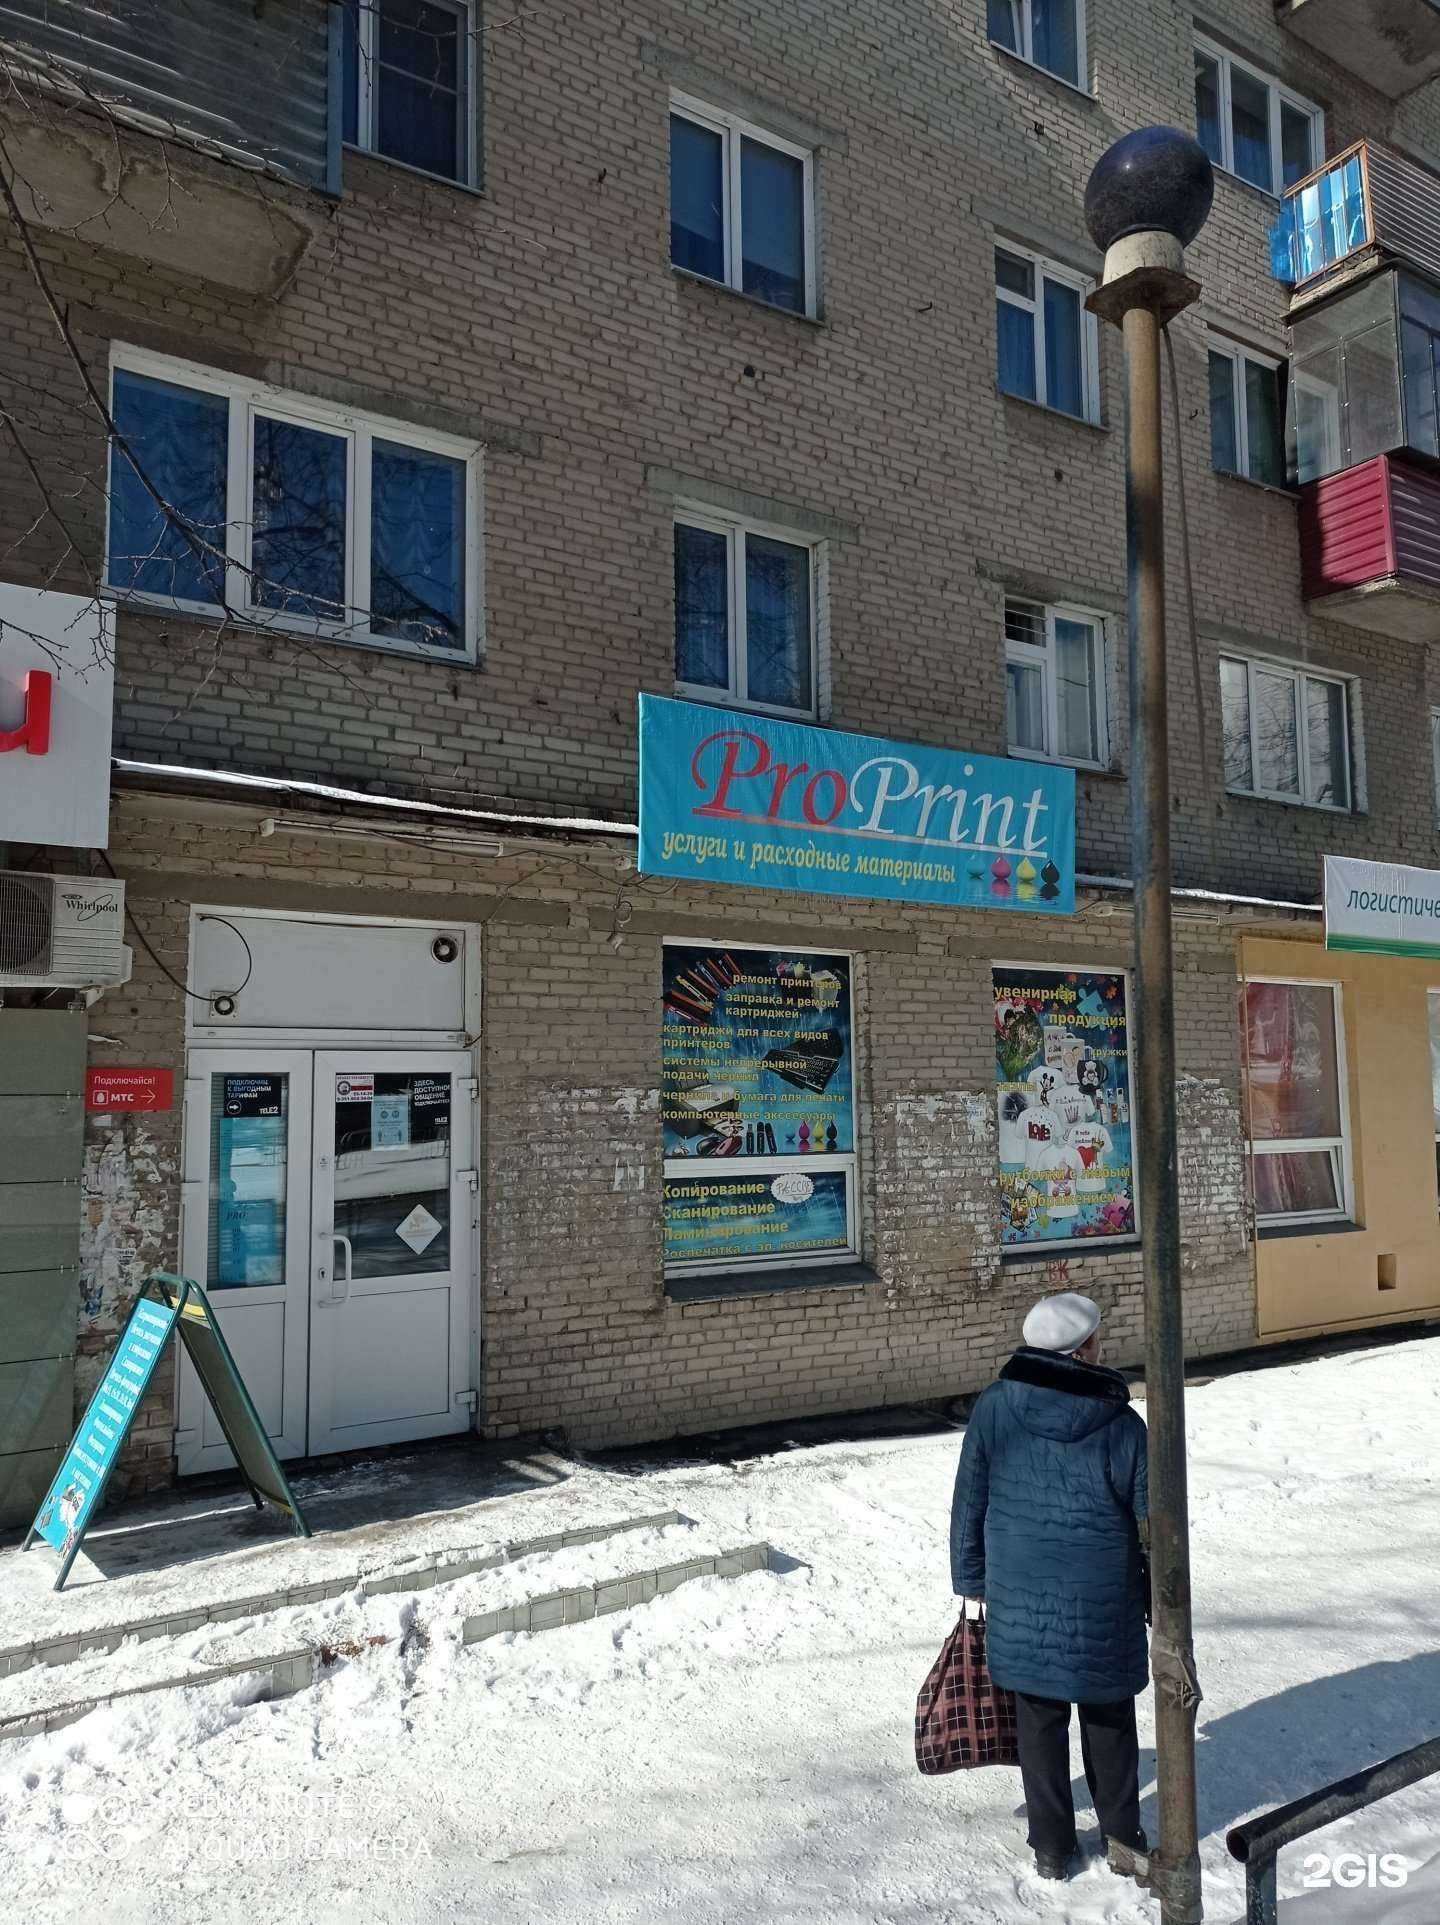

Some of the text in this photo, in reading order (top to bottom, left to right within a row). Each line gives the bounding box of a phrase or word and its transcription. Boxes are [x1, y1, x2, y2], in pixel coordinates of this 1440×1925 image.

[691, 730, 1048, 853] ProPrint
[661, 831, 957, 884] услуги и расходные материалы
[65, 899, 119, 915] Whirlpool
[1347, 889, 1440, 919] логистиче
[733, 974, 842, 990] ремонт принтеров
[726, 994, 841, 1009] заправка и ремонт
[725, 1006, 800, 1019] картриджей
[1049, 1013, 1127, 1028] продукция
[663, 1025, 829, 1042] картриджи для всех видов
[663, 1039, 731, 1050] принтеров
[663, 1056, 720, 1067] системы
[94, 1075, 156, 1087] Подключайся!
[663, 1070, 710, 1081] подачи
[413, 1079, 435, 1087] ЗДЕСЬ
[110, 1093, 135, 1102] МТС
[414, 1091, 446, 1101] ОБЩЕНИЕ
[734, 1089, 777, 1102] бумага
[780, 1092, 801, 1103] для
[259, 1106, 279, 1115] TELE2
[663, 1110, 760, 1121] компьютерные
[663, 1202, 776, 1220] Сканирование
